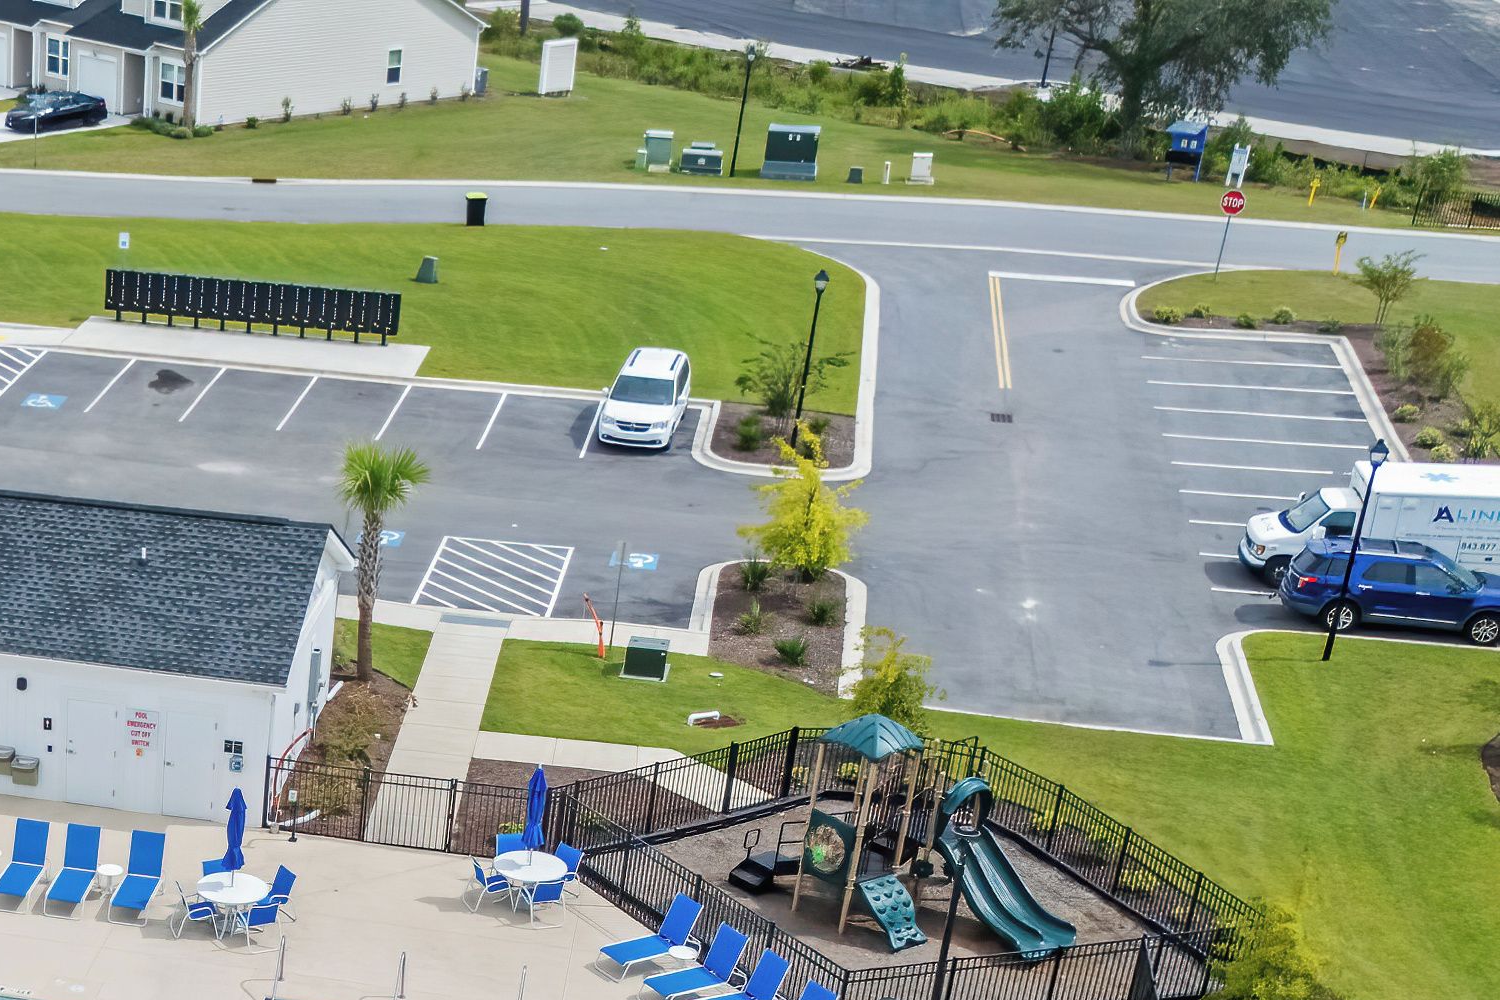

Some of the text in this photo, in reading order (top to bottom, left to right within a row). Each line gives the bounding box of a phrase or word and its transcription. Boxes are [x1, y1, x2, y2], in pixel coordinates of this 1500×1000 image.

[1222, 196, 1244, 208] STOP
[1432, 505, 1500, 523] ALIN
[135, 711, 148, 719] POOL
[126, 720, 156, 729] EMERGENCY
